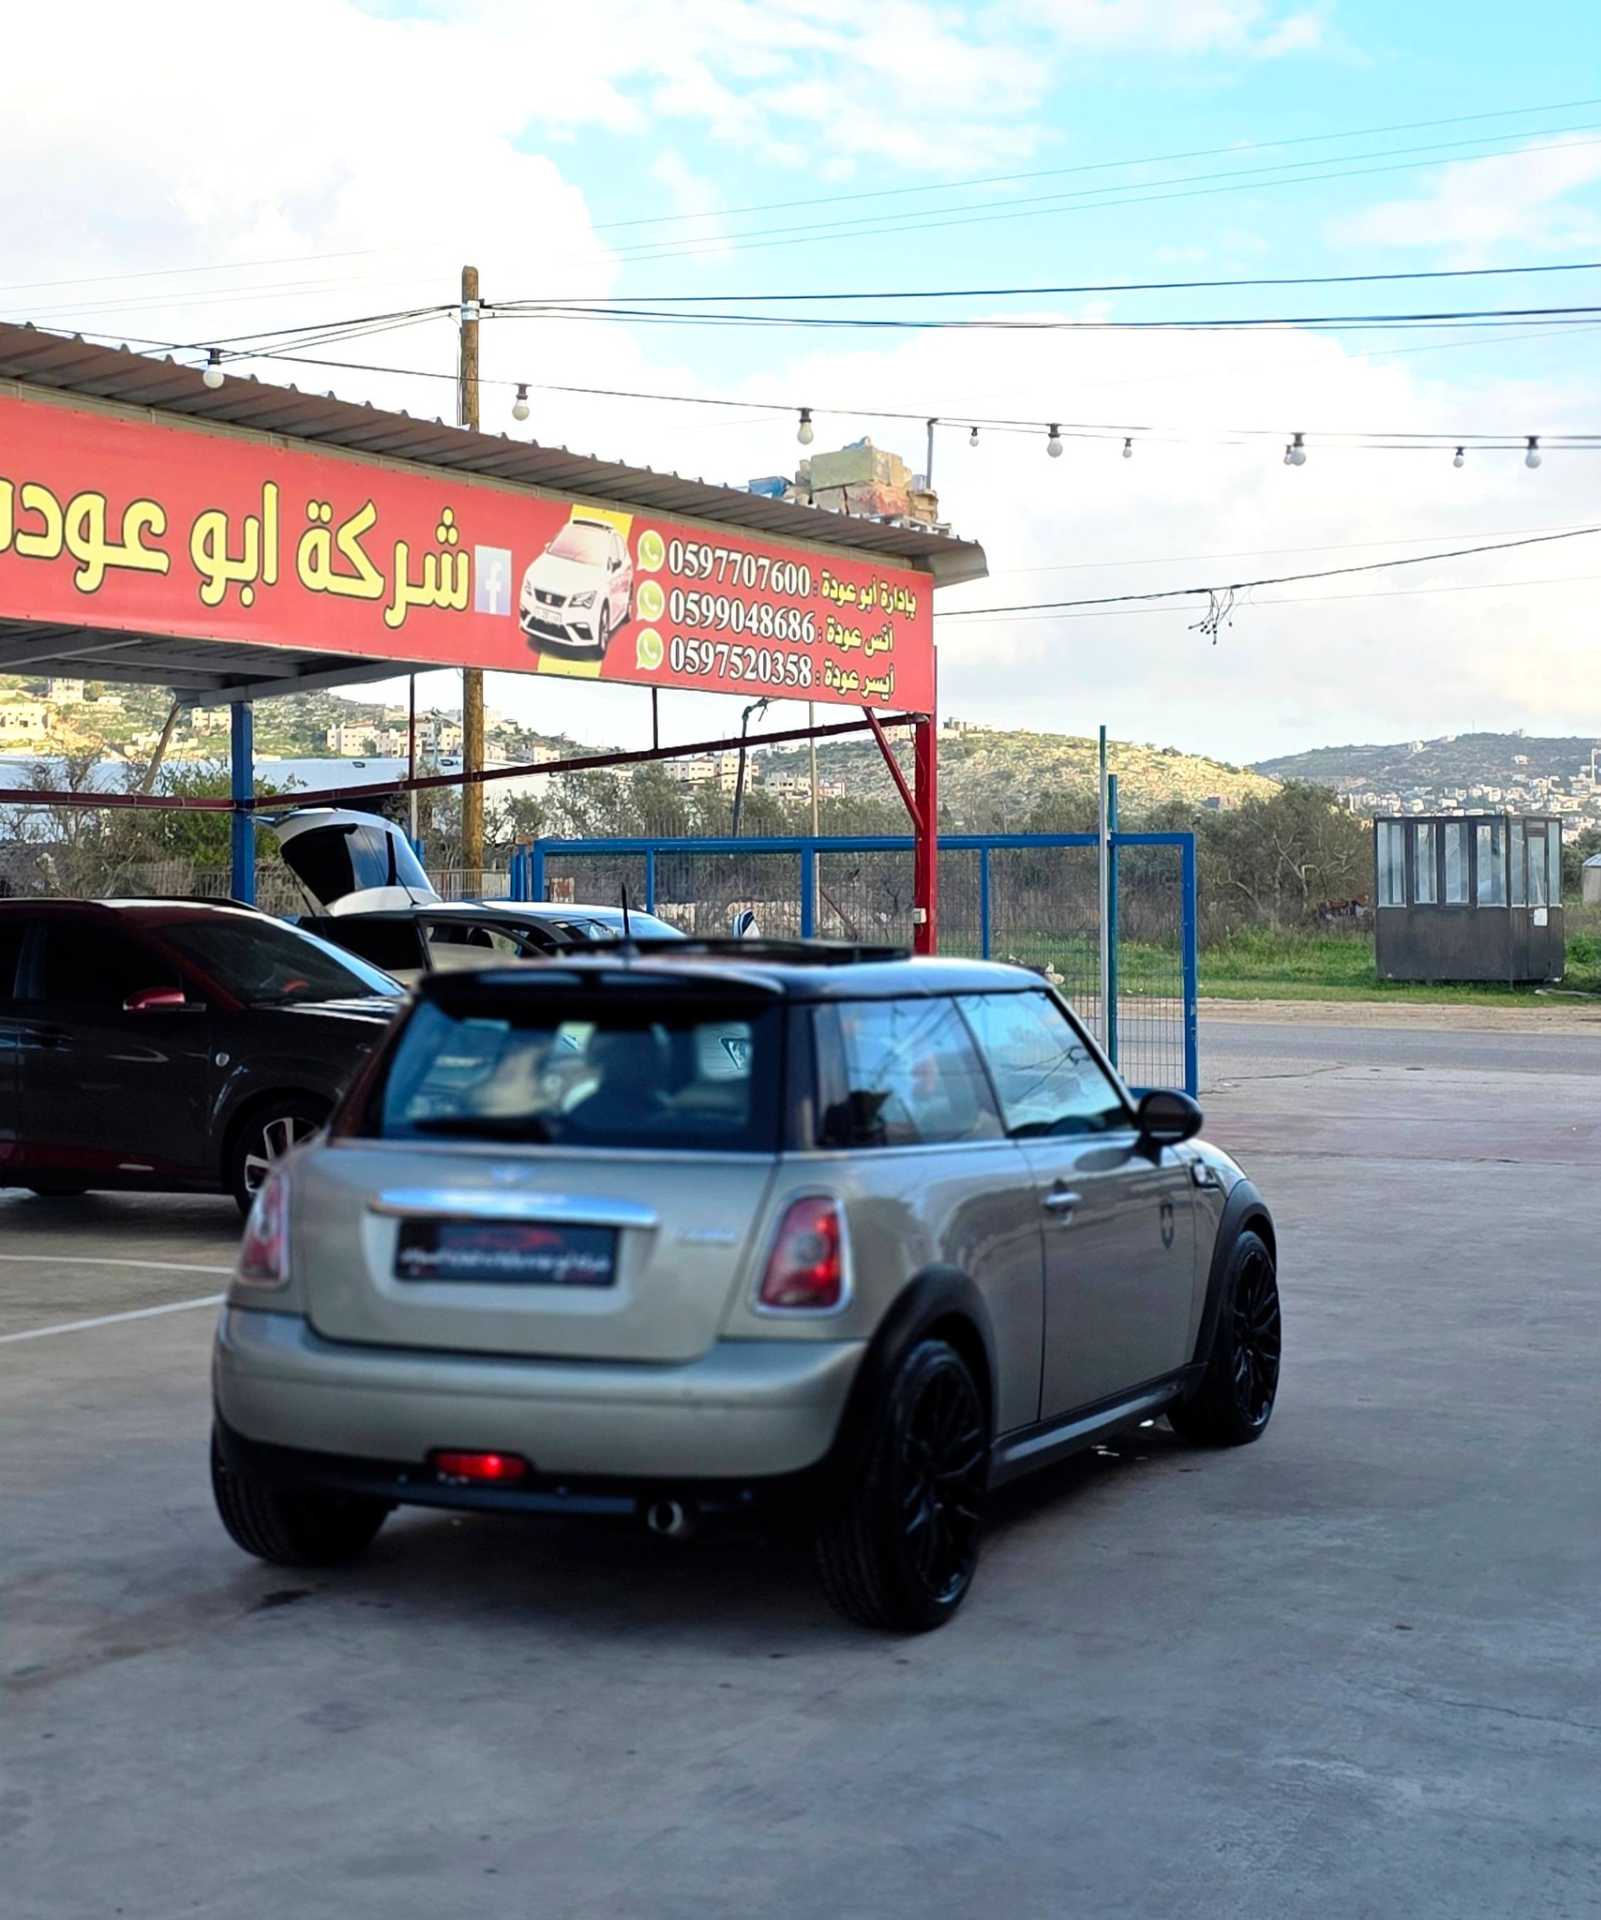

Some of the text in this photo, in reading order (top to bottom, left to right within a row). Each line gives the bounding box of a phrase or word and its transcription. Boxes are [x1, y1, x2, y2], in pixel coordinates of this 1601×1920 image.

[189, 480, 279, 608] ابو
[297, 499, 470, 628] شركة
[668, 539, 811, 598] 0597707600
[821, 569, 857, 608] عودة
[668, 588, 816, 644] 0599048686
[826, 615, 862, 652] عودة
[668, 636, 813, 688] 0597520358
[824, 658, 860, 695] عودة
